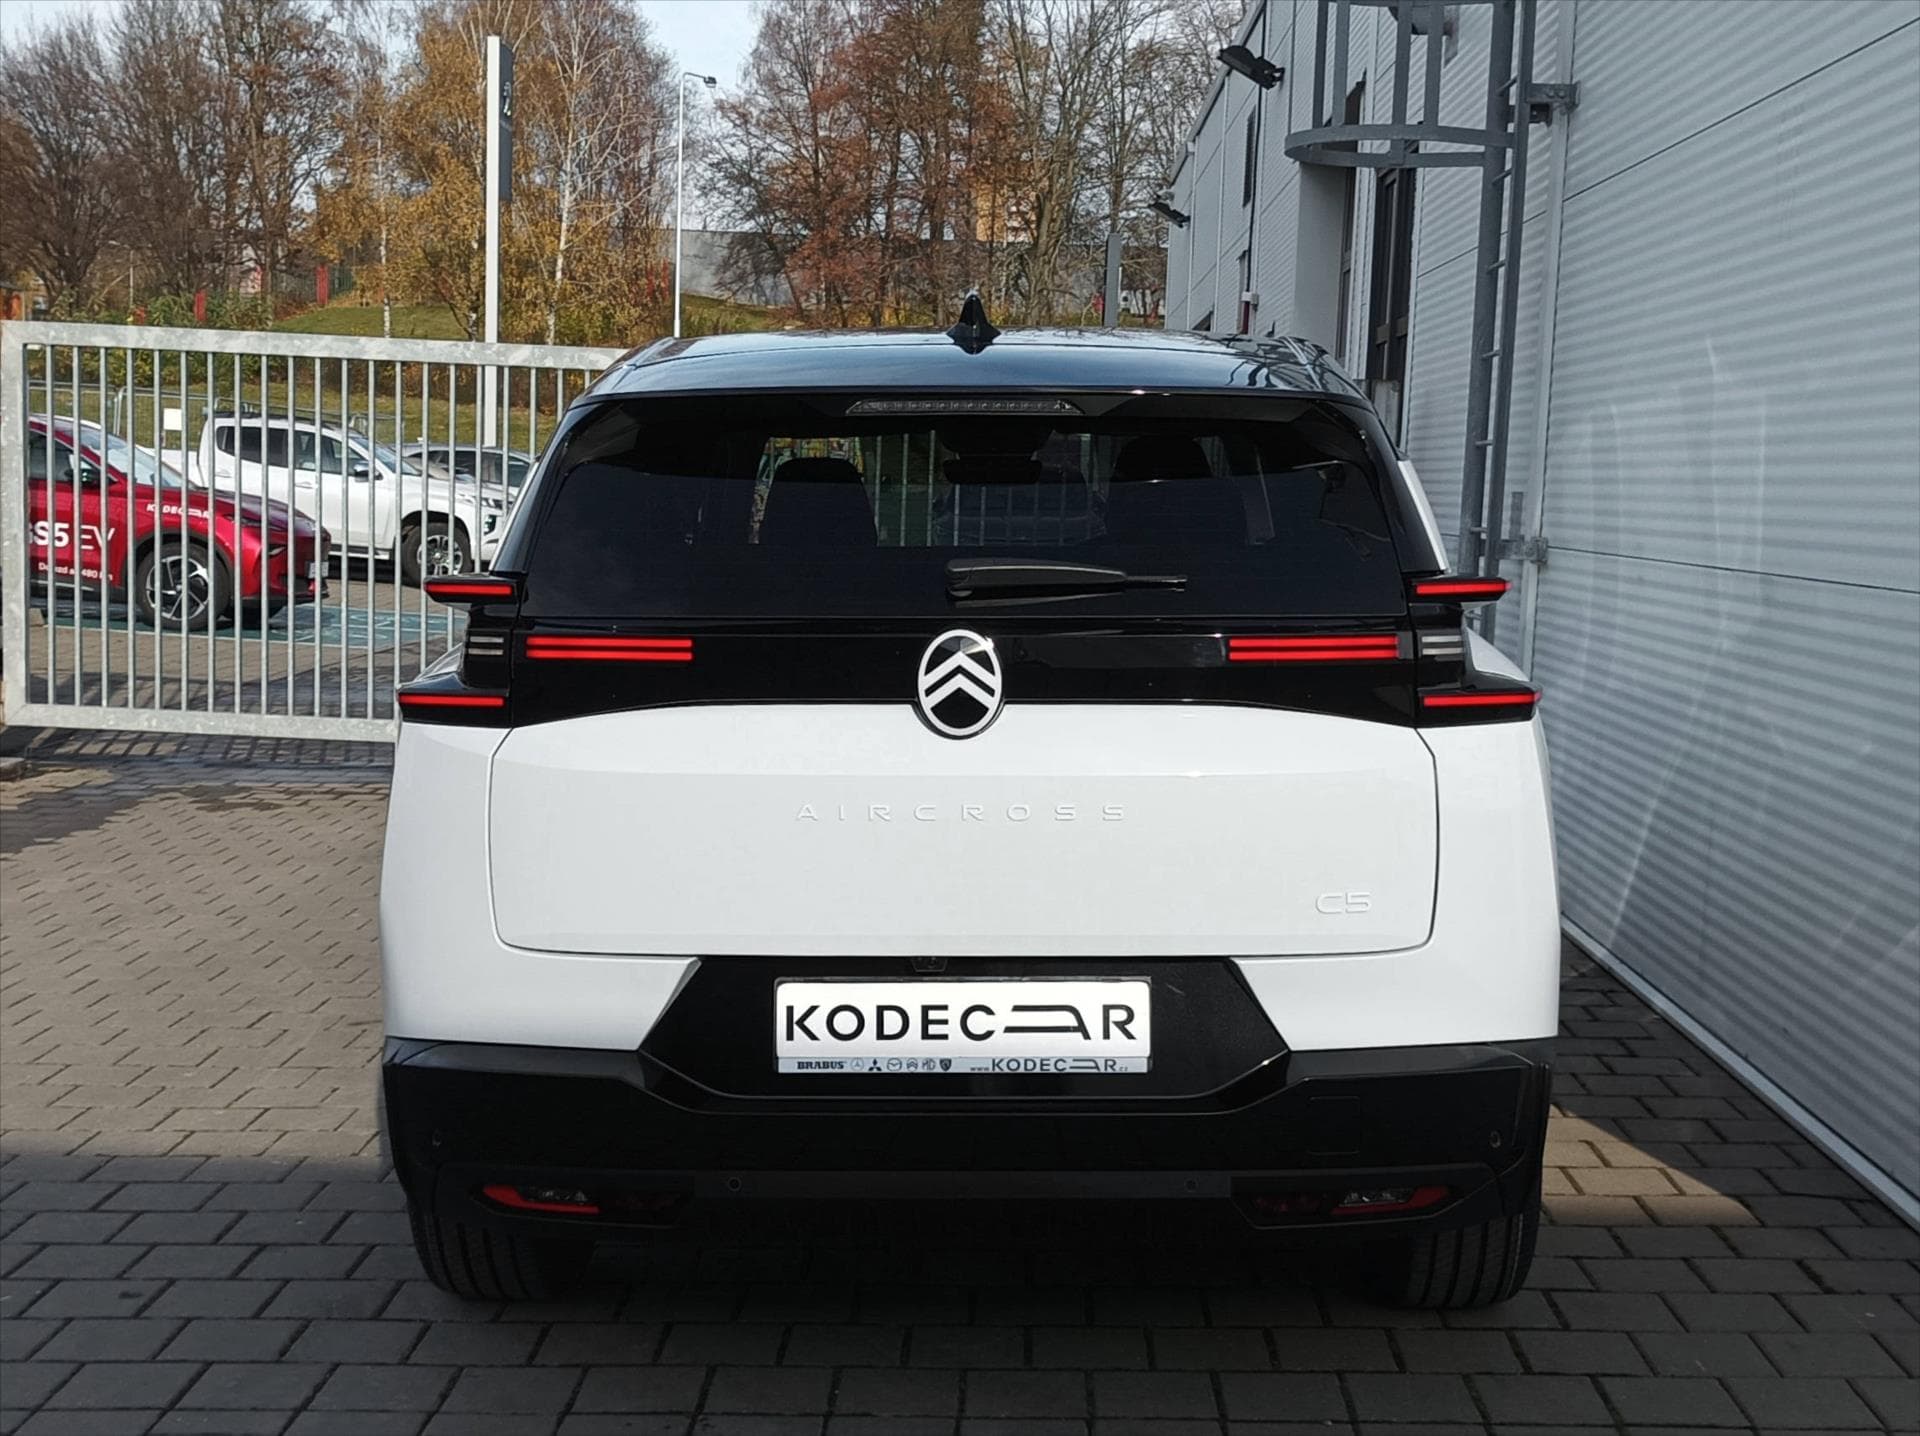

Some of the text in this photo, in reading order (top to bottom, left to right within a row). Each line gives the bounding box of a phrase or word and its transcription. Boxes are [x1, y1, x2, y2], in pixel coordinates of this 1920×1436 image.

[796, 803, 1126, 822] AIRCROSS
[1315, 891, 1371, 914] C5
[785, 1004, 1137, 1042] KODECAR
[797, 1061, 845, 1070] BRABUS
